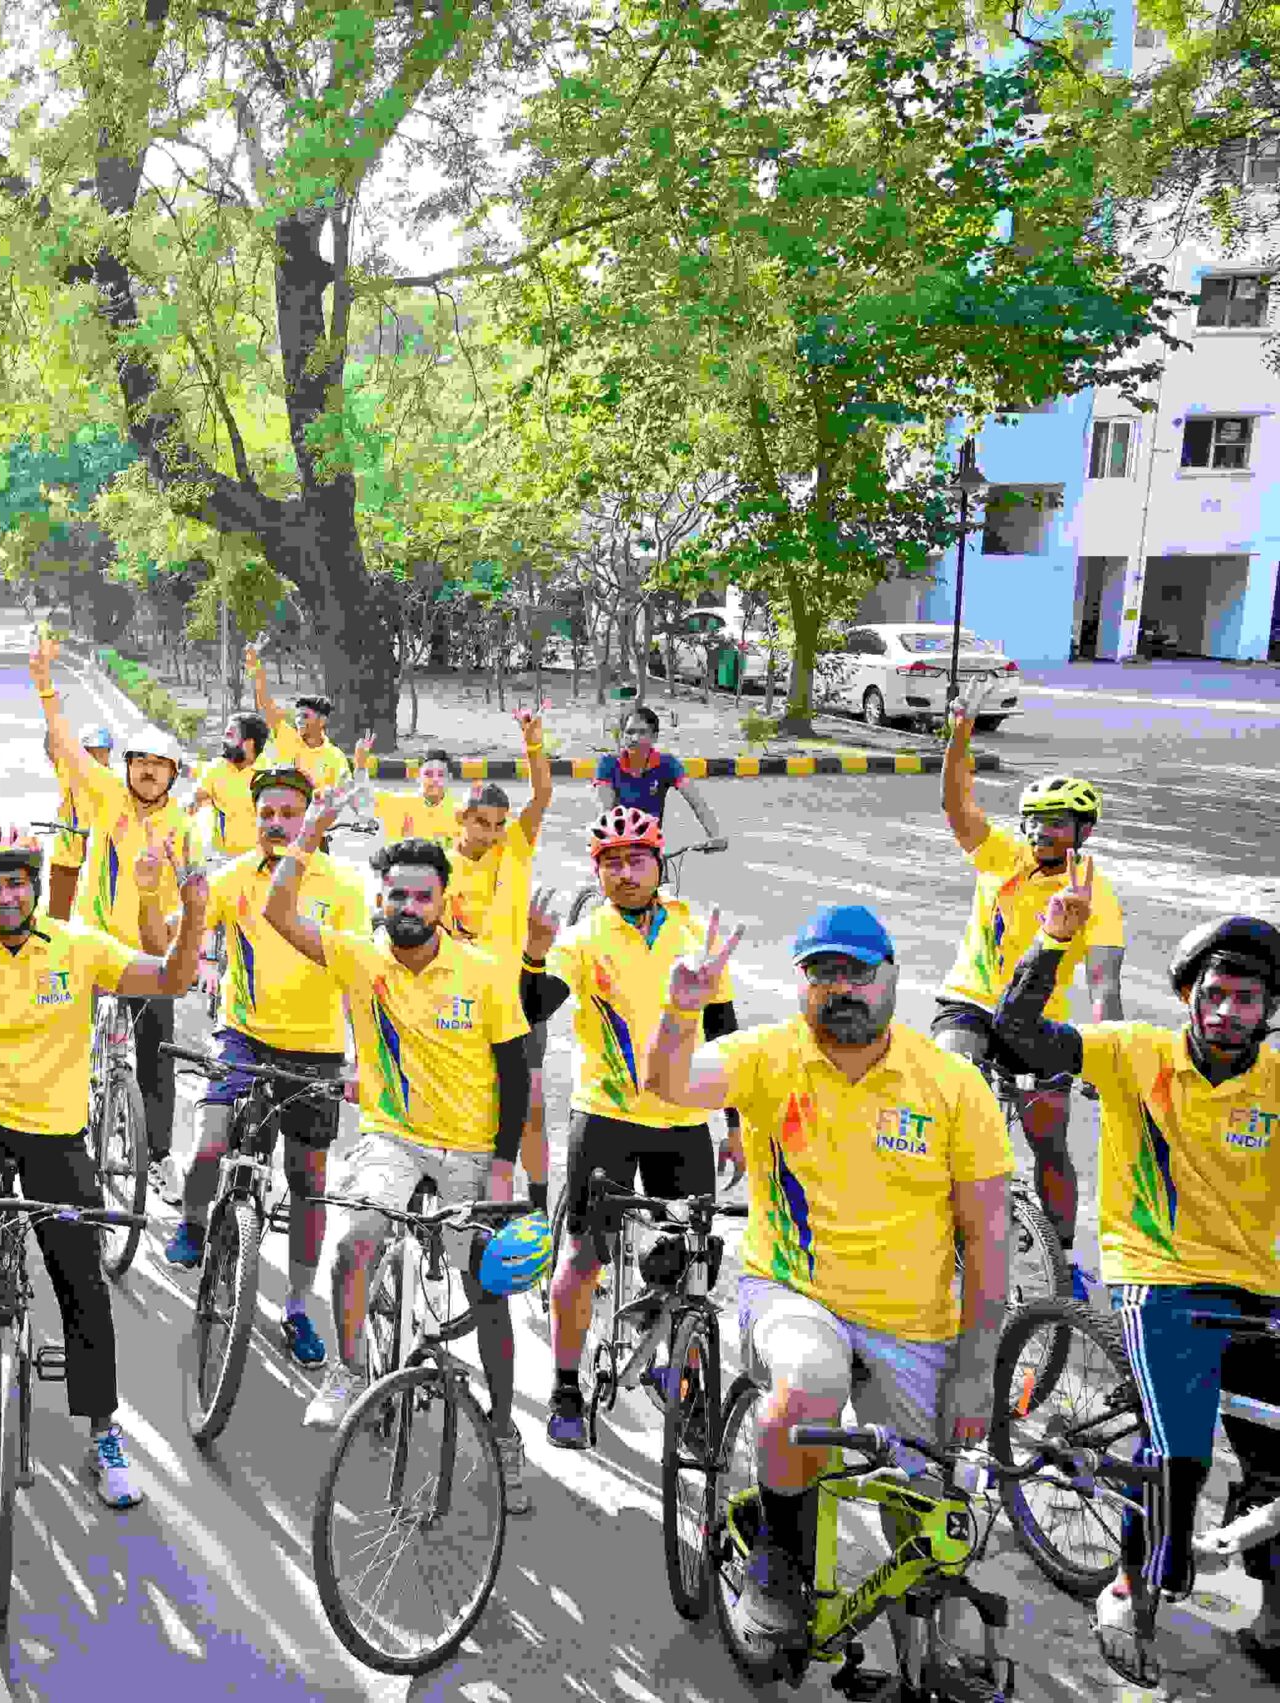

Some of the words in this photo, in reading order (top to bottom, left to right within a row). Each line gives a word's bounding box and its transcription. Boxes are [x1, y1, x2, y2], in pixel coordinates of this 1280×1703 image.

[37, 992, 73, 1005] INDIA
[435, 1017, 473, 1030] INDIA
[876, 1134, 927, 1154] INDIA
